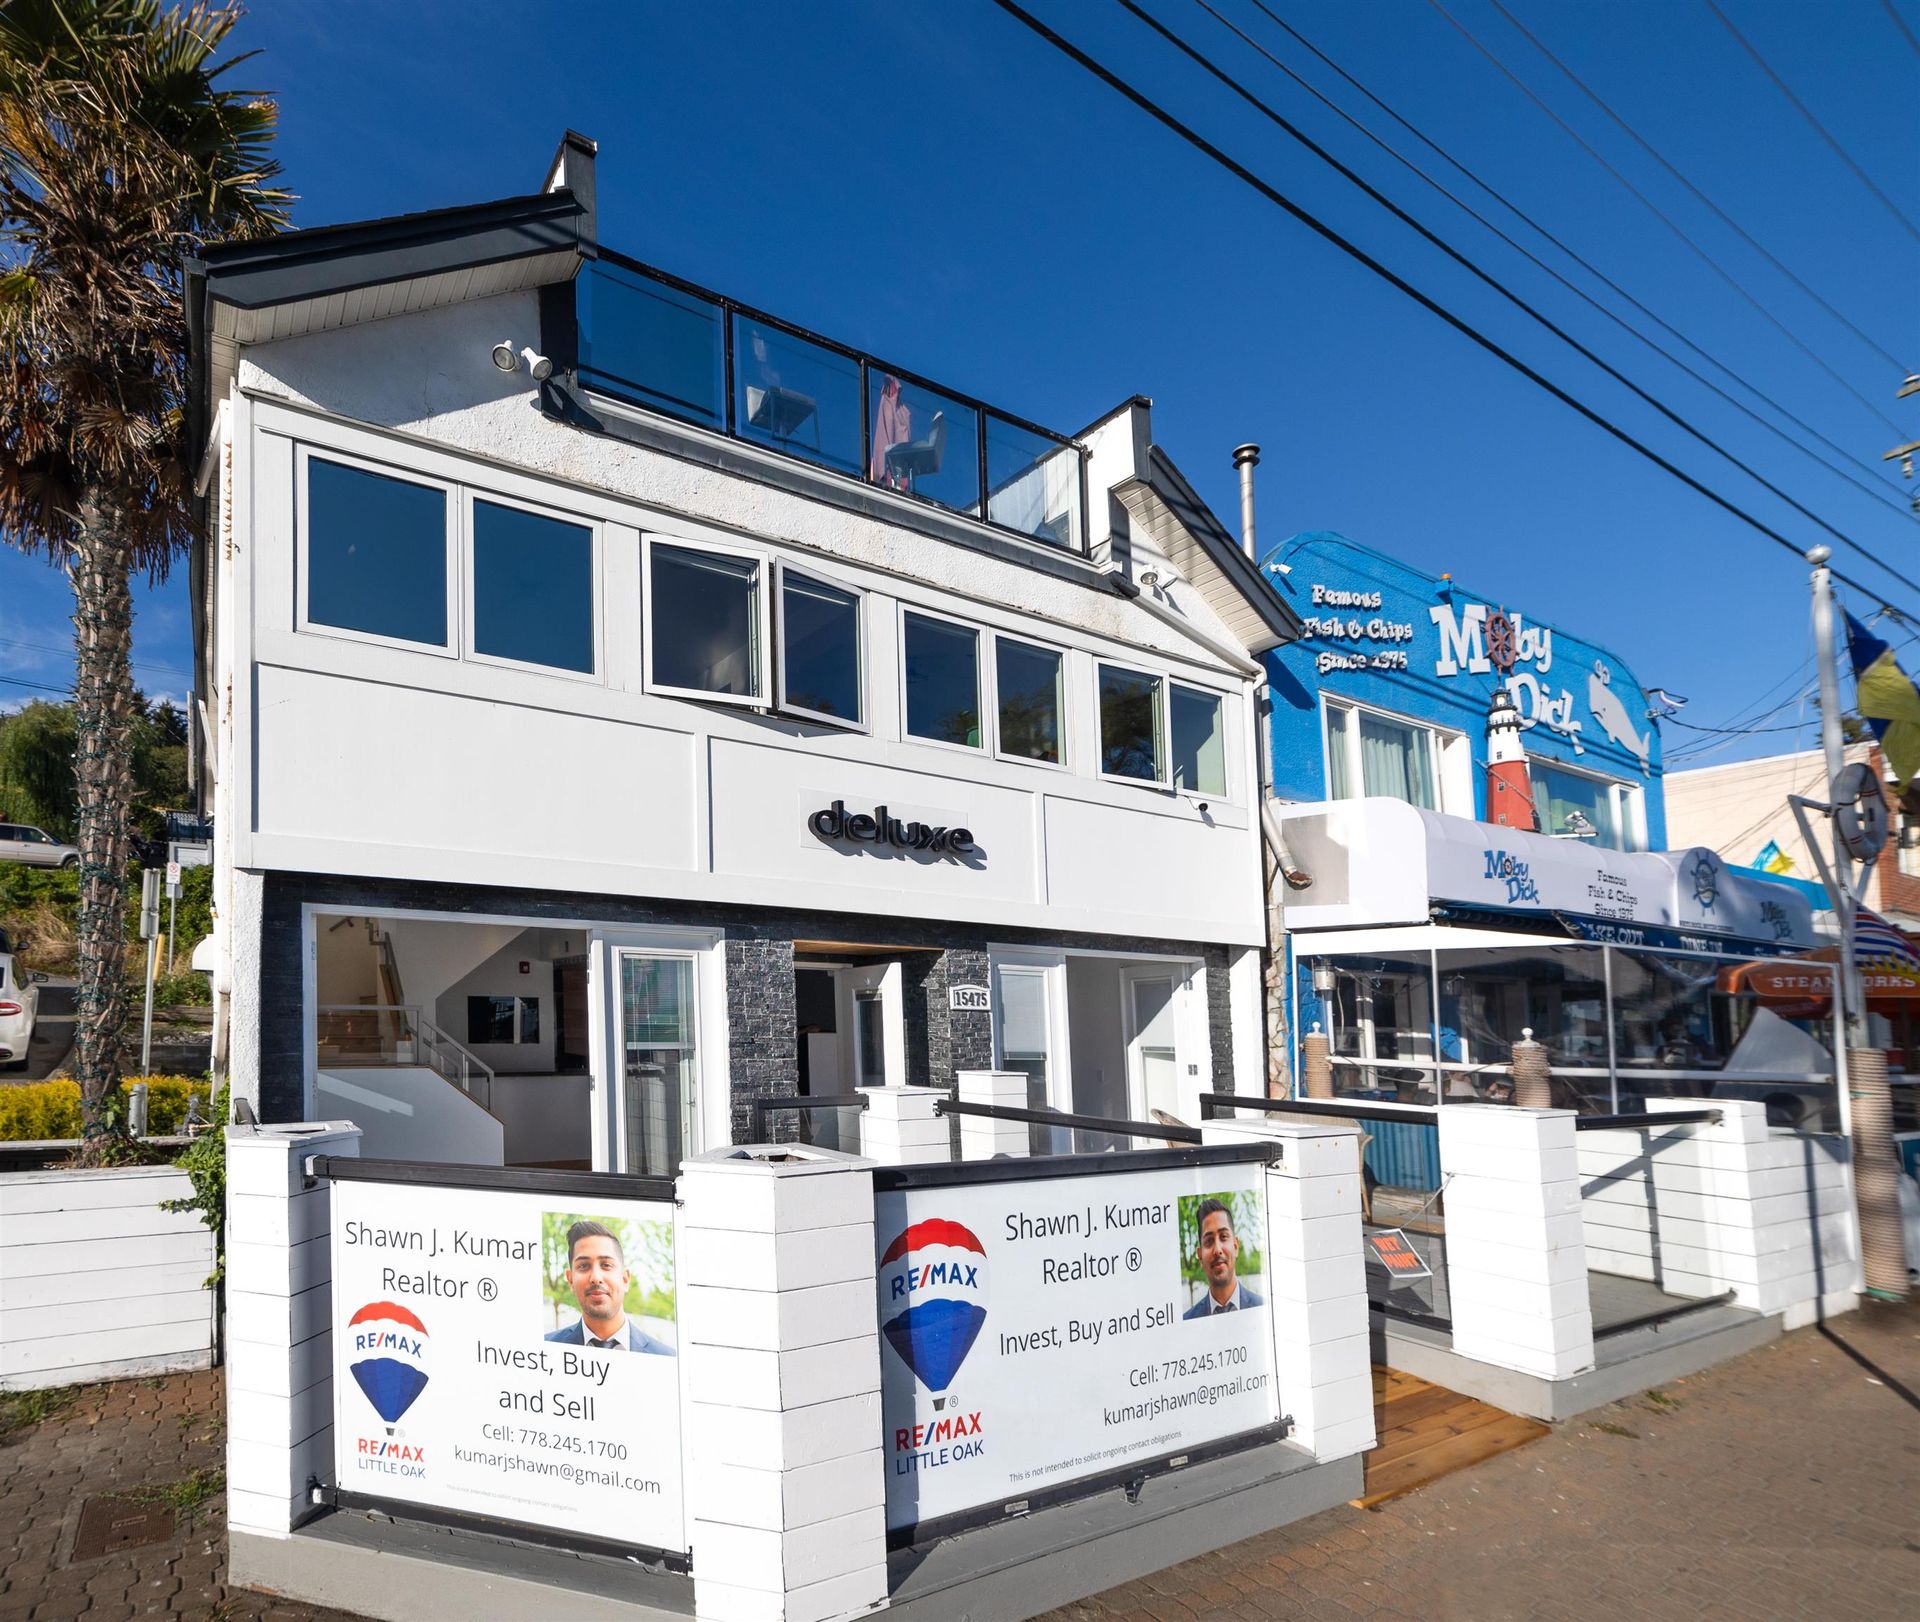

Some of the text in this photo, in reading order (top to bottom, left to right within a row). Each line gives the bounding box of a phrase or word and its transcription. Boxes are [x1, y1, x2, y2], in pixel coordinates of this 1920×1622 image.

[1311, 584, 1381, 608] Famous
[1303, 617, 1413, 642] Fish & Chips
[1429, 603, 1552, 676] Moby
[1317, 651, 1408, 673] Since 1975
[1505, 672, 1585, 755] Dick
[808, 800, 974, 853] deluxe
[1484, 850, 1529, 882] Moby
[1597, 869, 1627, 886] Famous
[1506, 877, 1540, 904] Dick
[1588, 885, 1638, 908] Fish & Chips
[1595, 903, 1616, 918] Since
[1618, 927, 1645, 946] OUT
[1772, 975, 1916, 988] STEAORKS
[953, 991, 988, 1007] 15475
[1005, 1202, 1171, 1241] Shawn J. Kumar
[345, 1221, 537, 1261] Shawn J. Kumar
[382, 1267, 468, 1299] Realtor
[891, 1262, 978, 1301] RE/MAX
[1043, 1252, 1118, 1285] Realtor
[356, 1332, 422, 1359] RE/MAX
[1000, 1303, 1174, 1356] Invest, Buy and Sell
[477, 1340, 610, 1386] Invest, Buy
[1129, 1345, 1248, 1387] Cell: 778.245.1700
[499, 1388, 596, 1421] and Sell
[1104, 1373, 1270, 1426] kumarjshawn@gmail.com
[482, 1423, 628, 1461] Cell: 778.245.1700
[895, 1411, 982, 1452] RE/MAX
[358, 1438, 424, 1462] RE/MAX
[896, 1439, 984, 1476] LITTLE OAK
[1009, 1431, 1182, 1483] This is not intended to solicit ongoing contact obligations
[358, 1457, 426, 1479] LITTLE OAK
[454, 1445, 661, 1495] kumarjshawn@gmail.com
